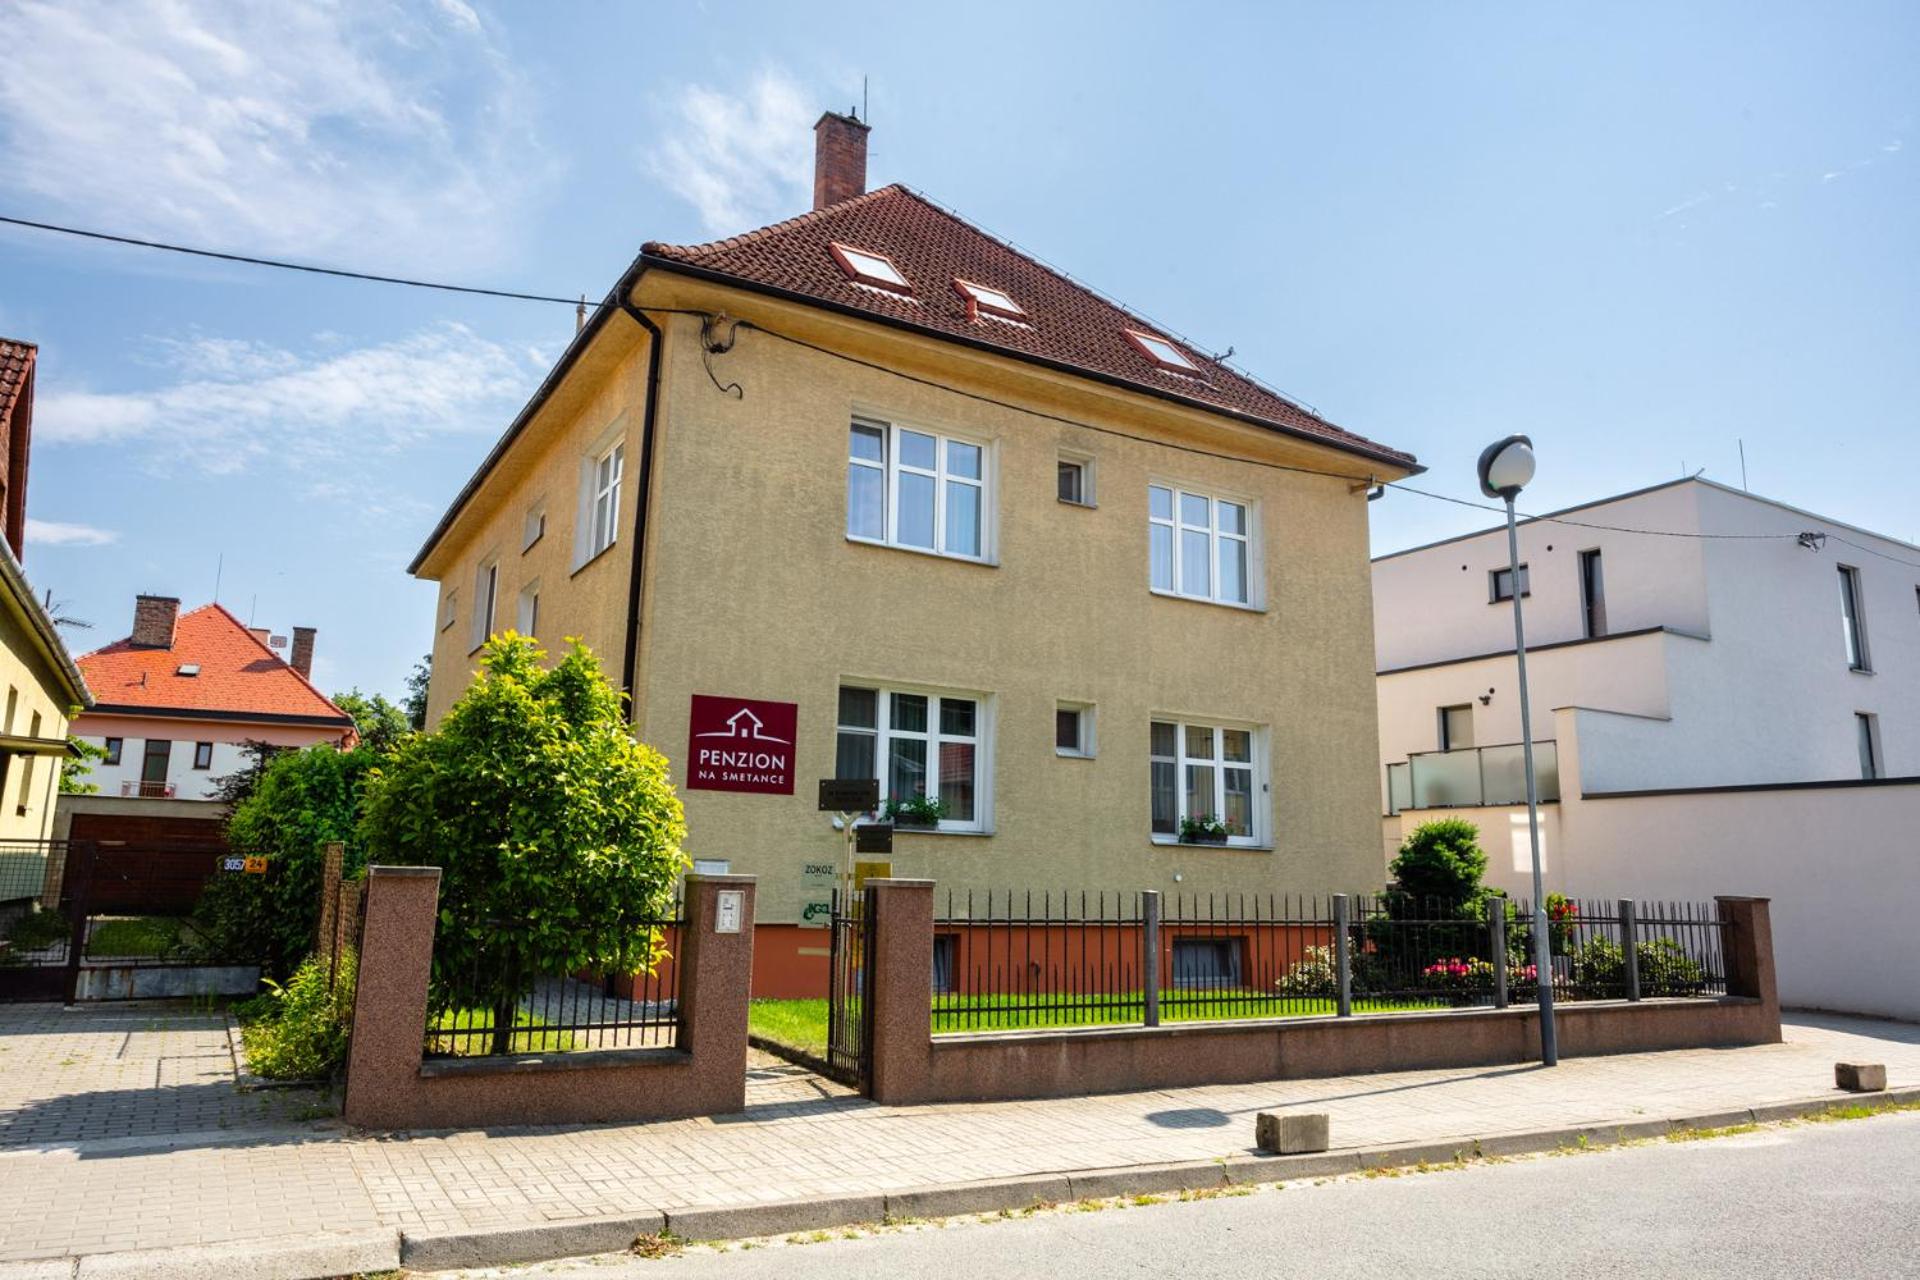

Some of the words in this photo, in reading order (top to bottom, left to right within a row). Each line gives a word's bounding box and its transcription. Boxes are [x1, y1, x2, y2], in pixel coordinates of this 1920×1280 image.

[699, 749, 785, 770] PENZION
[698, 770, 716, 780] NA
[722, 772, 785, 784] SMETANCE
[249, 859, 263, 869] 24
[805, 865, 833, 874] ZOKOZ
